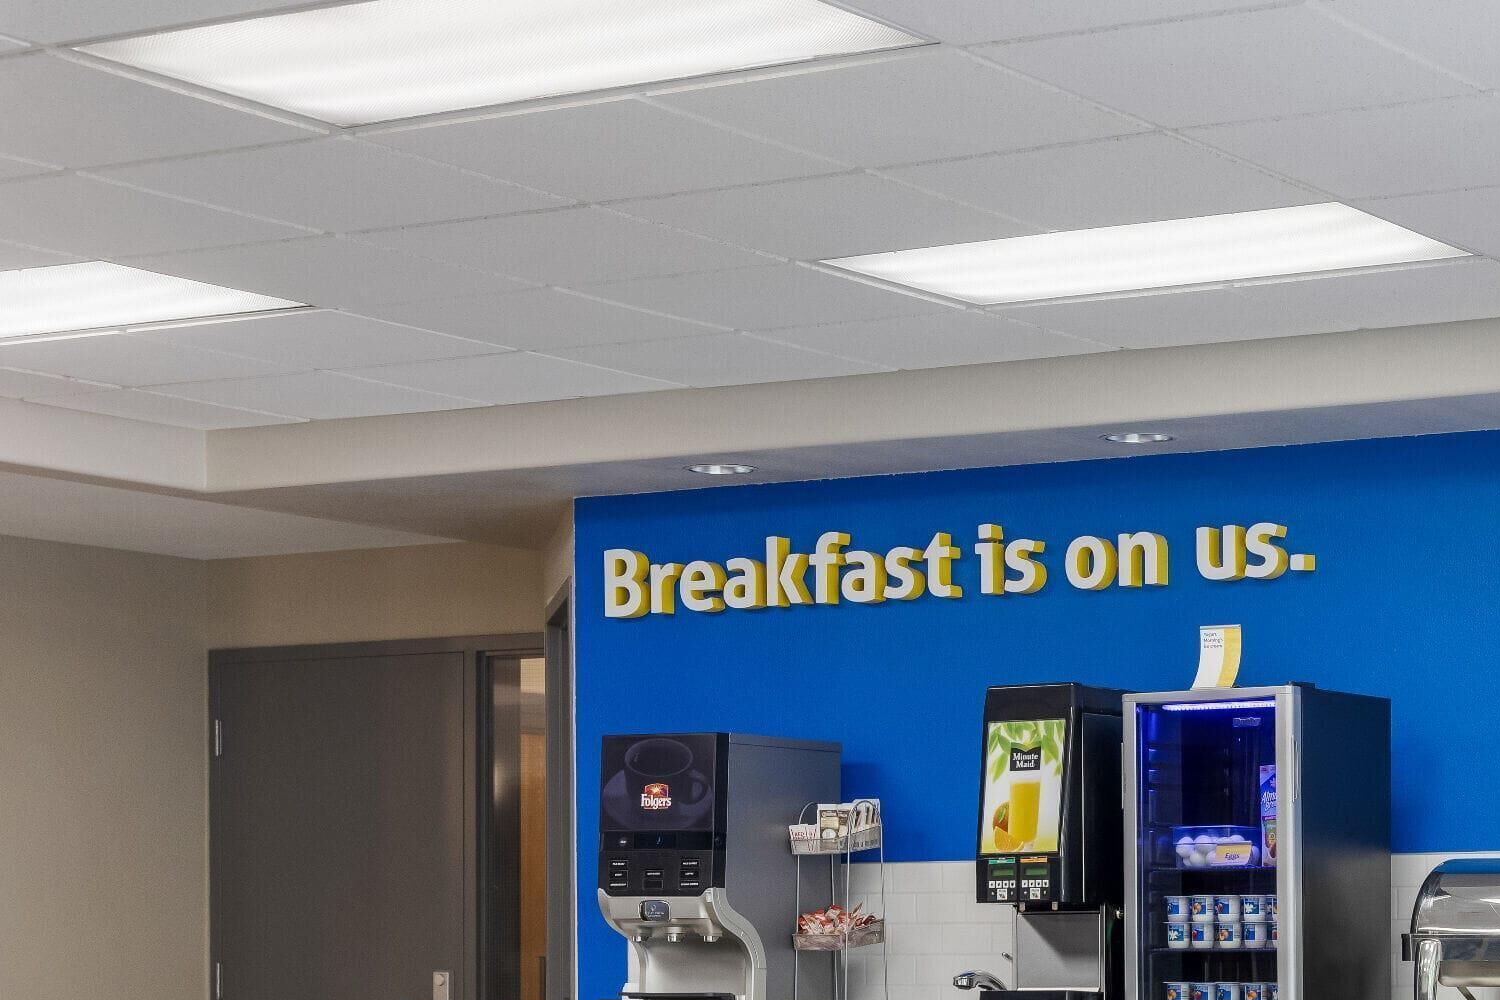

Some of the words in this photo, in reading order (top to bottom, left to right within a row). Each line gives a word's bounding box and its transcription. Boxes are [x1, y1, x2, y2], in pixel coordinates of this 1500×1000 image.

[604, 531, 963, 619] Breakfast
[975, 522, 1046, 595] is
[1064, 530, 1168, 590] on
[1196, 521, 1315, 581] us.
[1012, 752, 1039, 761] Minute
[1015, 760, 1035, 769] Maid
[641, 793, 672, 810] Folgers
